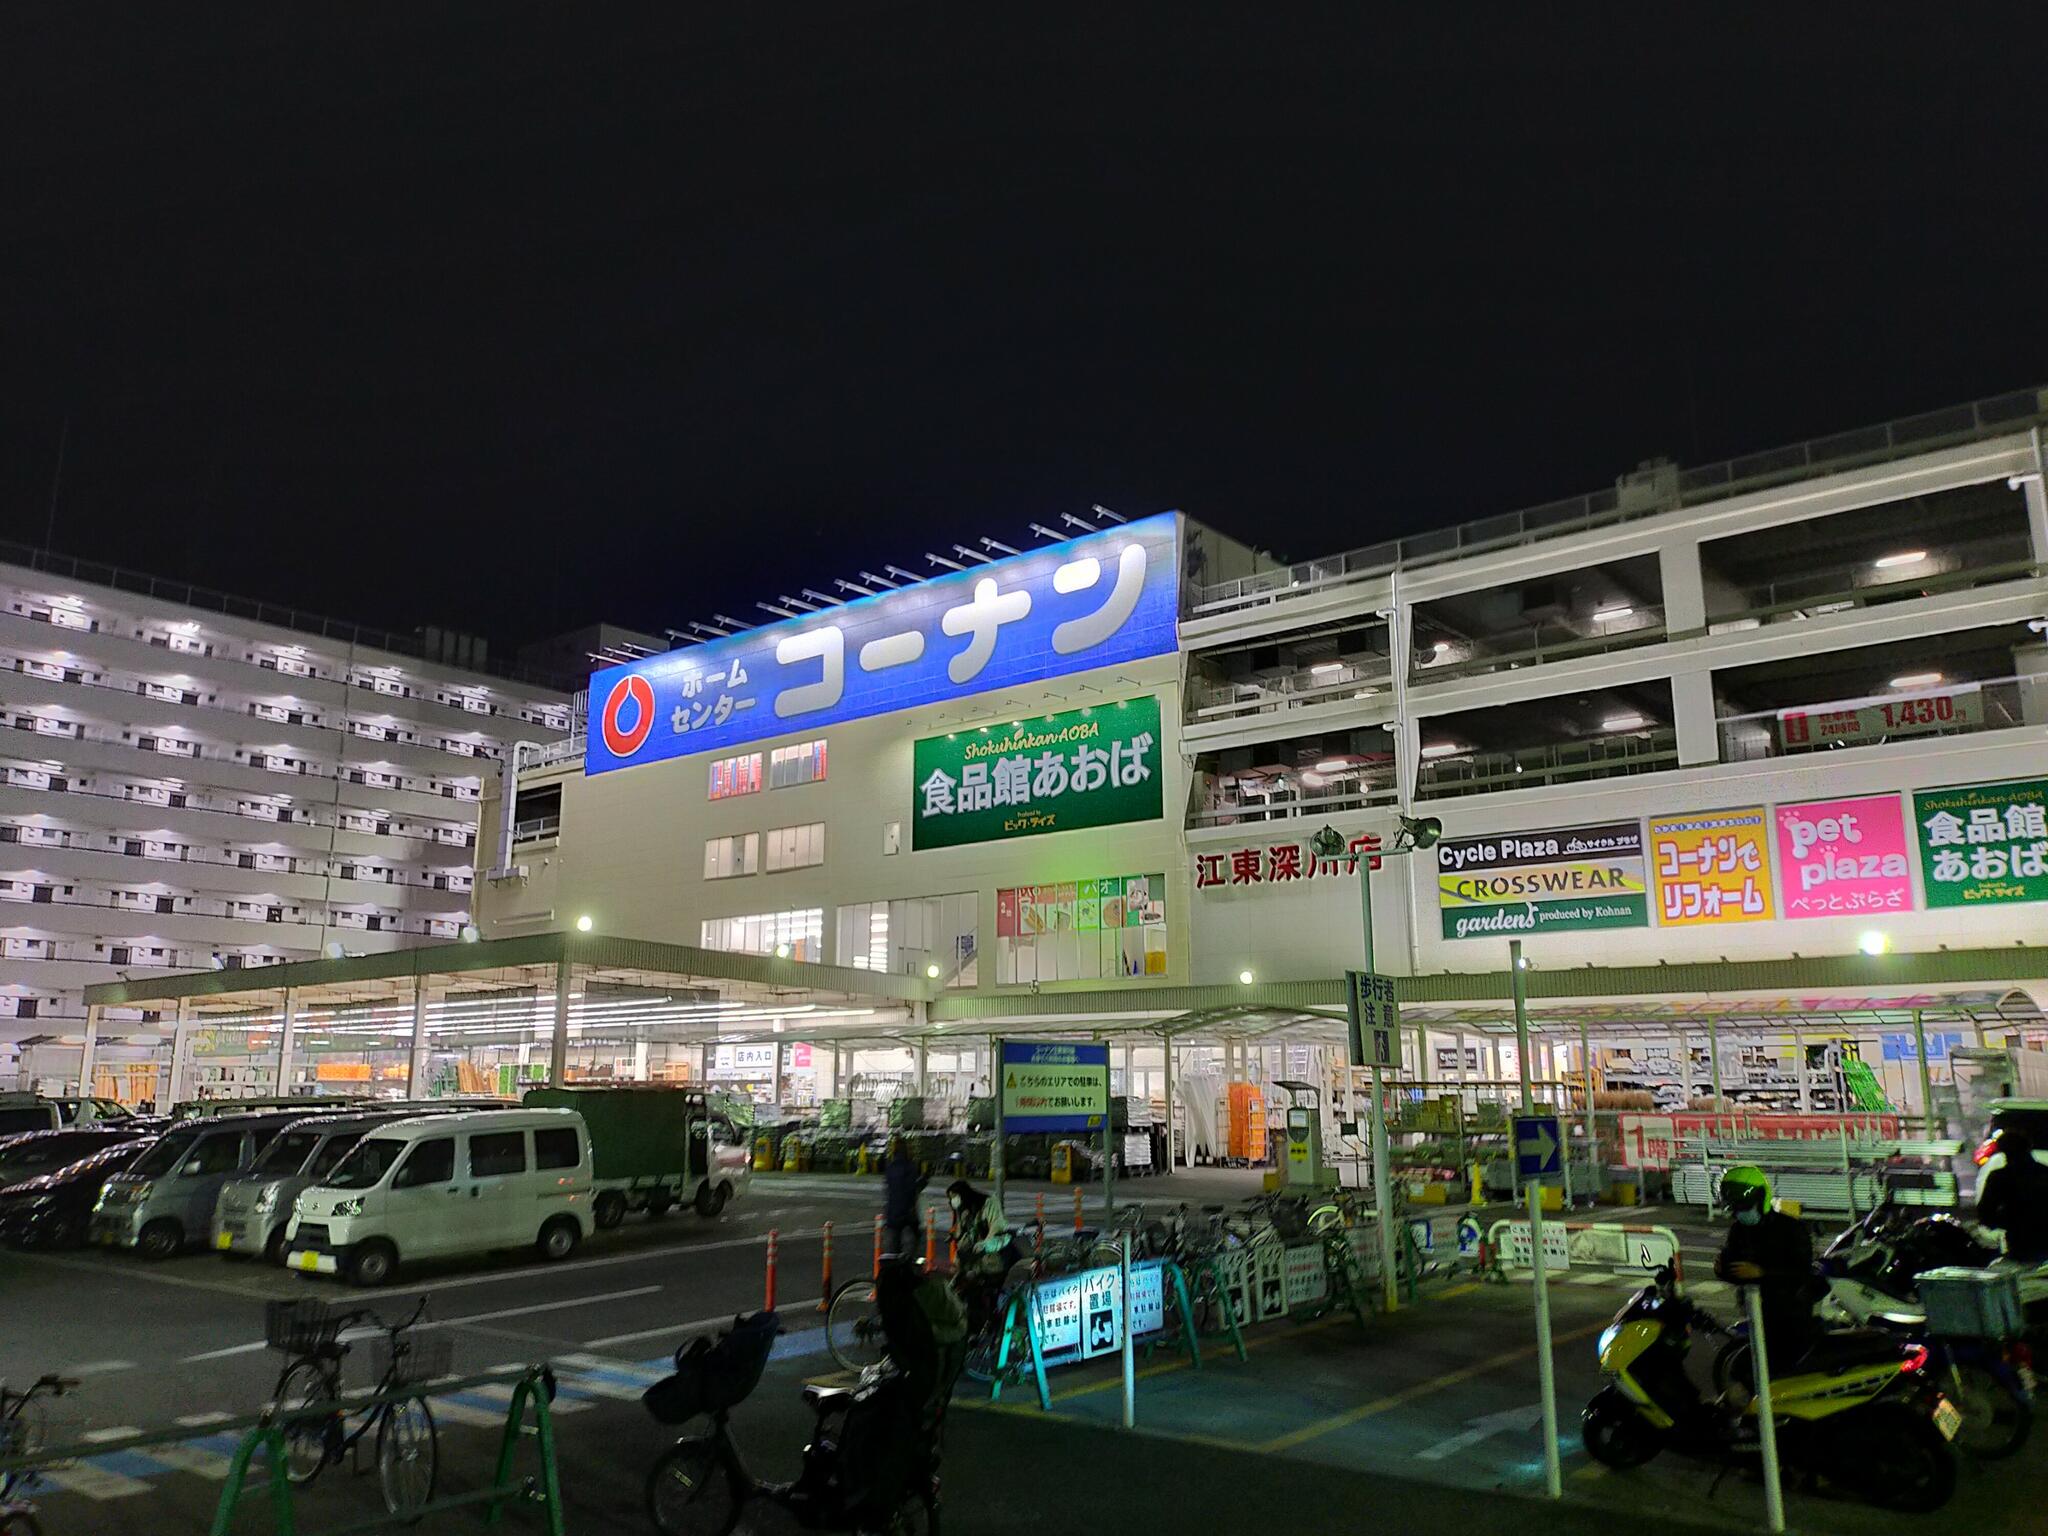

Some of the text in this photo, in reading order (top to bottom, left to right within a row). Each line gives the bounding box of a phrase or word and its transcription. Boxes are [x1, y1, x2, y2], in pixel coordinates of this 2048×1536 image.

[776, 543, 1146, 718] コーナン
[682, 658, 748, 698] ホーム
[671, 694, 756, 734] センター
[920, 731, 1154, 818] 食品館あおば
[1791, 813, 1863, 860] pet
[1923, 803, 2047, 847] 食品館
[1439, 839, 1559, 869] Cycle Plaza
[1658, 835, 1762, 877] コーナンで
[1800, 850, 1908, 892] plaza
[1932, 840, 2048, 882] あおば
[1457, 867, 1626, 898] CROSSWEAR
[1663, 875, 1765, 920] リフォーム
[1791, 888, 1905, 911] ぺっとぷらざ
[1456, 901, 1632, 938] gardens produced by Kohnan
[1360, 975, 1395, 1002] 歩行者
[1364, 1001, 1395, 1028] 注意
[737, 1050, 772, 1062] 店内入口
[1084, 1273, 1115, 1293] バイク
[1089, 1290, 1112, 1310] 置場
